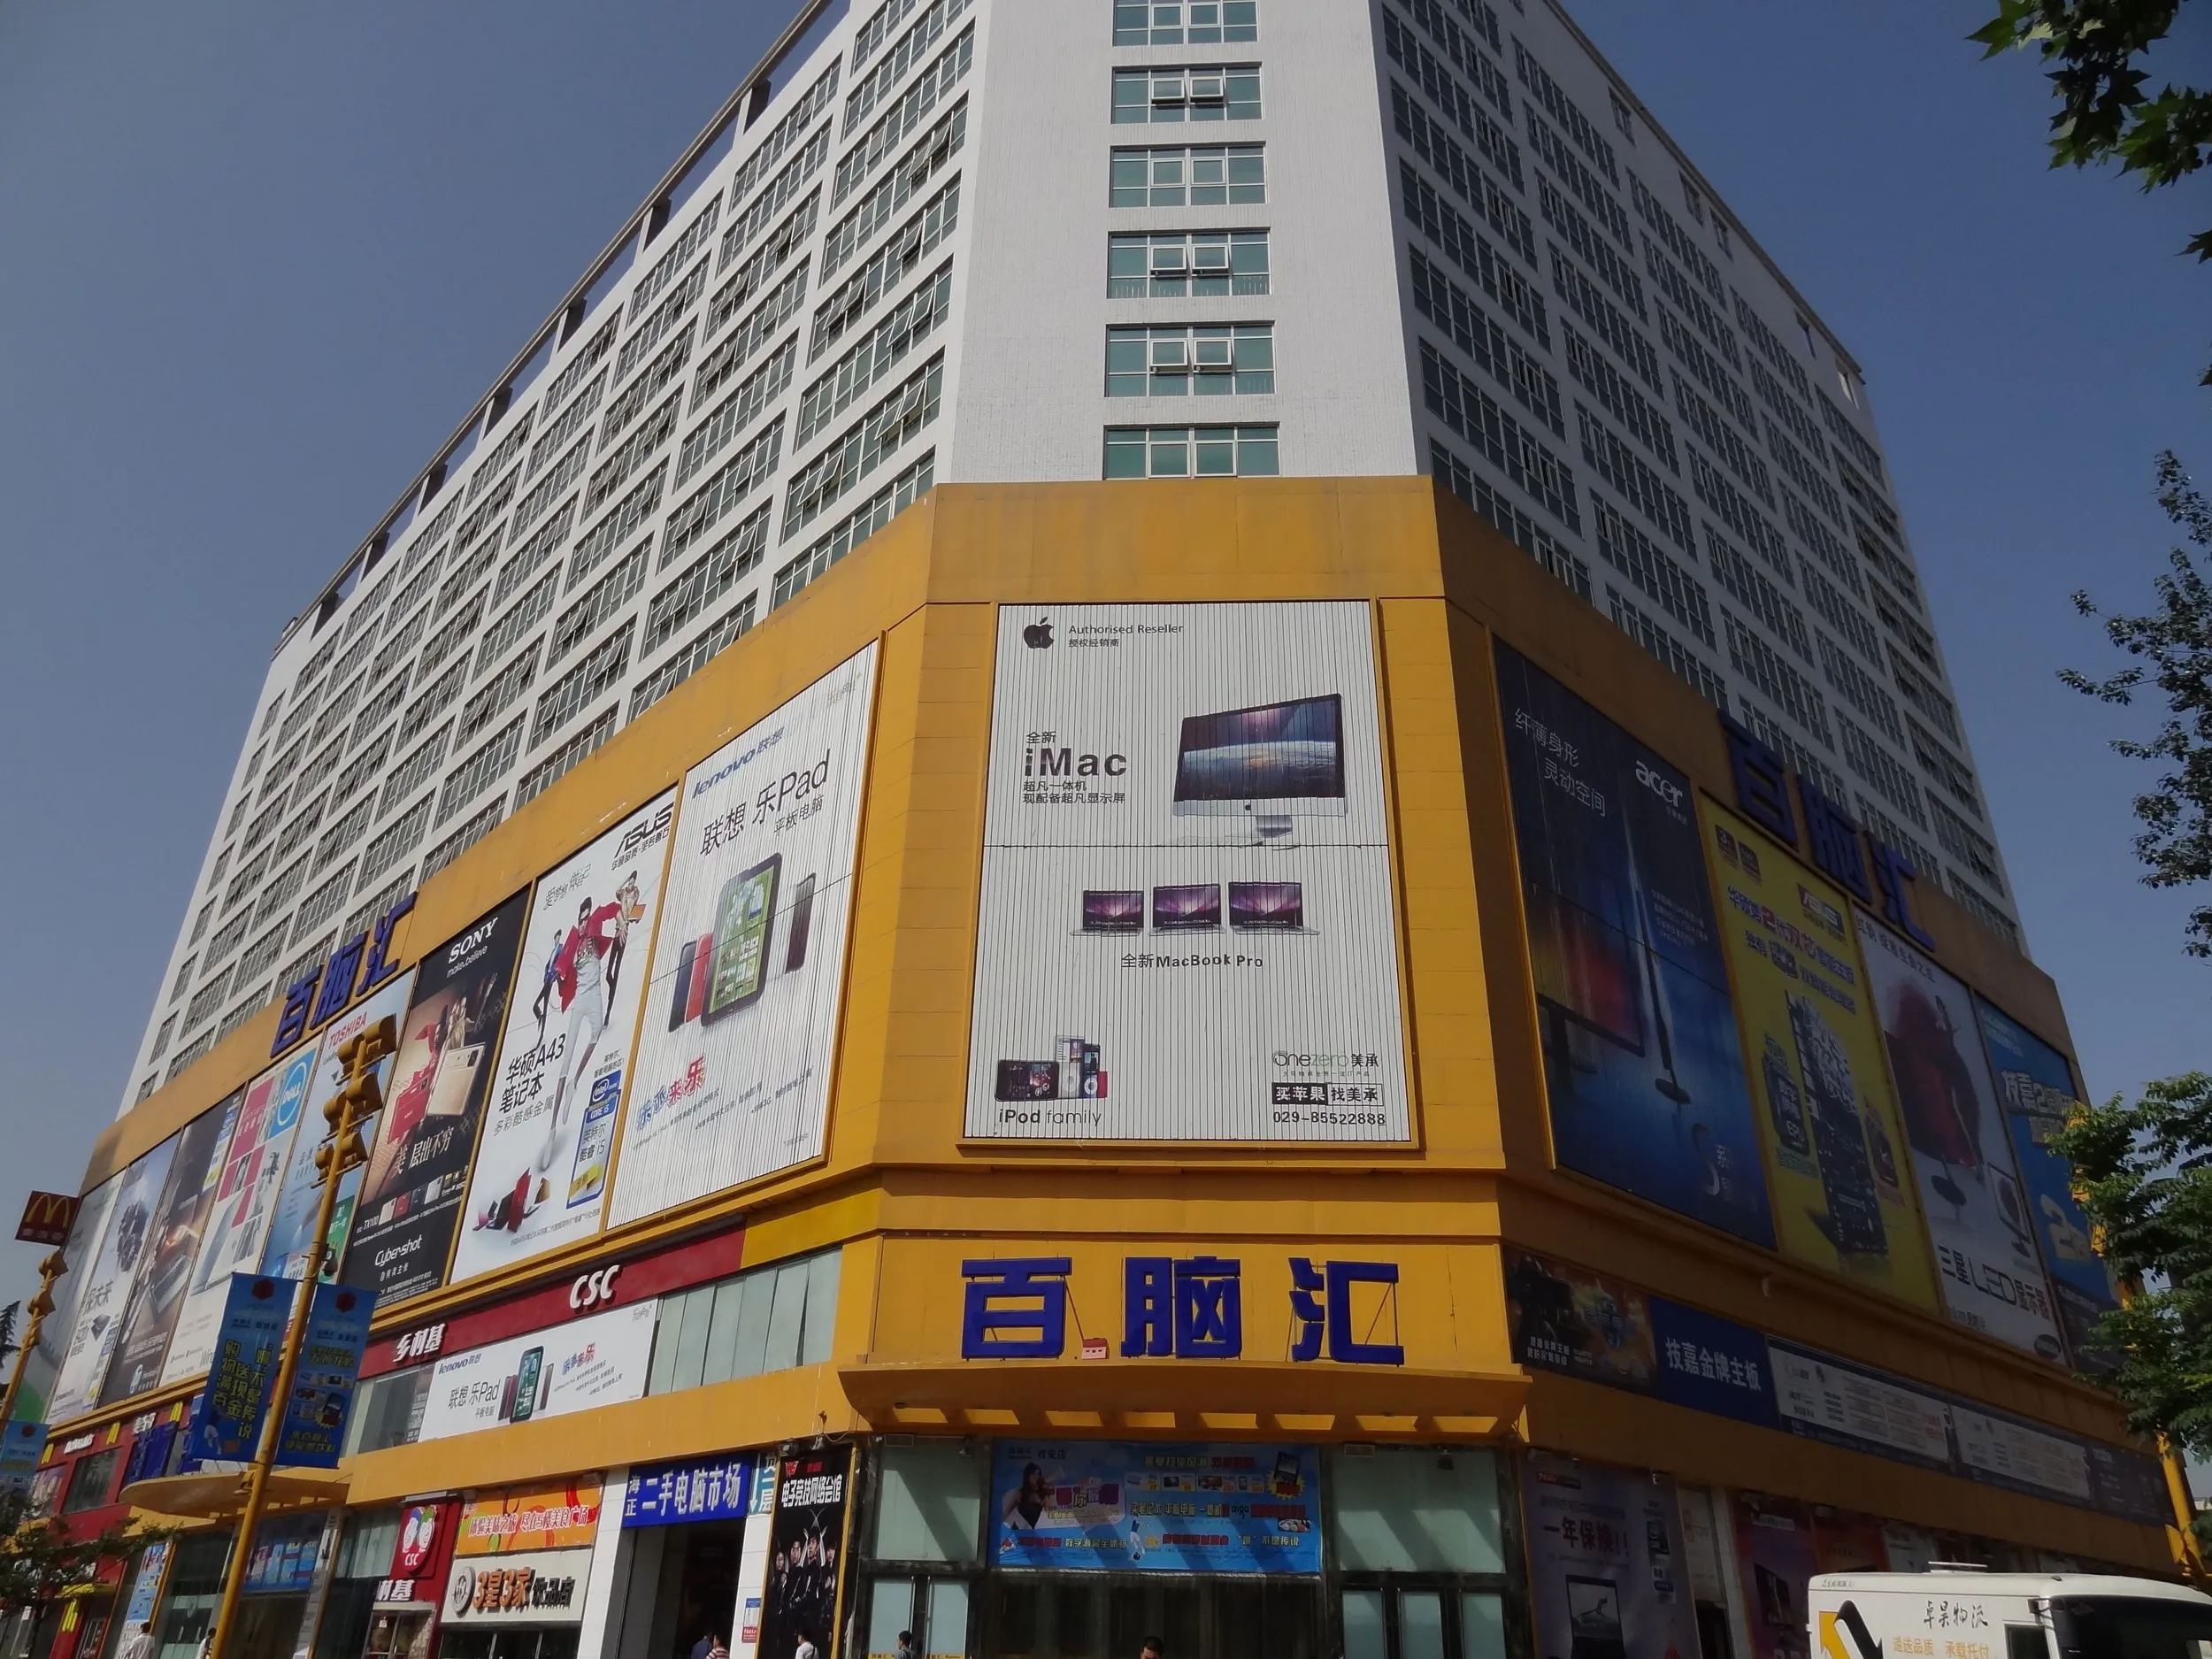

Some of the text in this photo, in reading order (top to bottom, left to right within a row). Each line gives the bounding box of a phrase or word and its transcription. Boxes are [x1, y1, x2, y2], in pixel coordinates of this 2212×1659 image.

[1068, 638, 1119, 648] 授权经销商
[1069, 623, 1183, 634] Authorised Reseller
[1026, 731, 1056, 744] 全新
[1515, 708, 1579, 768] 纤薄身形
[692, 748, 755, 799] lenovo
[1025, 748, 1127, 777] iMac
[700, 748, 831, 856] 联想 乐Pad
[1023, 780, 1087, 792] 超凡一体机
[1023, 792, 1125, 804] 现配备超凡显示屏
[1544, 757, 1606, 817] 灵动空间
[1635, 760, 1683, 808] acer
[614, 802, 673, 858] ASUS
[773, 794, 825, 836] 平板电脑
[1717, 708, 1935, 953] 百脑汇
[449, 917, 499, 964] SONY
[270, 891, 418, 1058] 百脑汇
[1237, 955, 1263, 968] Pro
[329, 1012, 367, 1048] TOSHIBA
[505, 1033, 566, 1085] 华硕A43
[1351, 1053, 1379, 1067] 美承
[499, 1071, 545, 1114] 笔记本
[1276, 1086, 1378, 1102] 买苹果 找美承
[494, 1094, 554, 1136] 多彩酷感金属
[582, 1124, 607, 1144] 英特尔
[999, 1109, 1102, 1126] iPod family
[1273, 1111, 1386, 1125] 029-85522888
[409, 1125, 455, 1170] 层出不穷
[570, 1264, 619, 1309] CSC
[962, 1256, 1405, 1365] 百脑汇
[393, 1323, 445, 1363] 乡村基
[438, 1357, 468, 1376] lenovo
[1664, 1337, 1761, 1391] 技嘉金牌主板
[448, 1379, 502, 1409] 联想 乐Pad
[642, 1462, 741, 1517] 二手电脑市场
[781, 1473, 843, 1508] 电子竞技网络会馆
[469, 1504, 589, 1538] 体验美味之旅 尽在5楼美食广场
[404, 1553, 419, 1566] CSC
